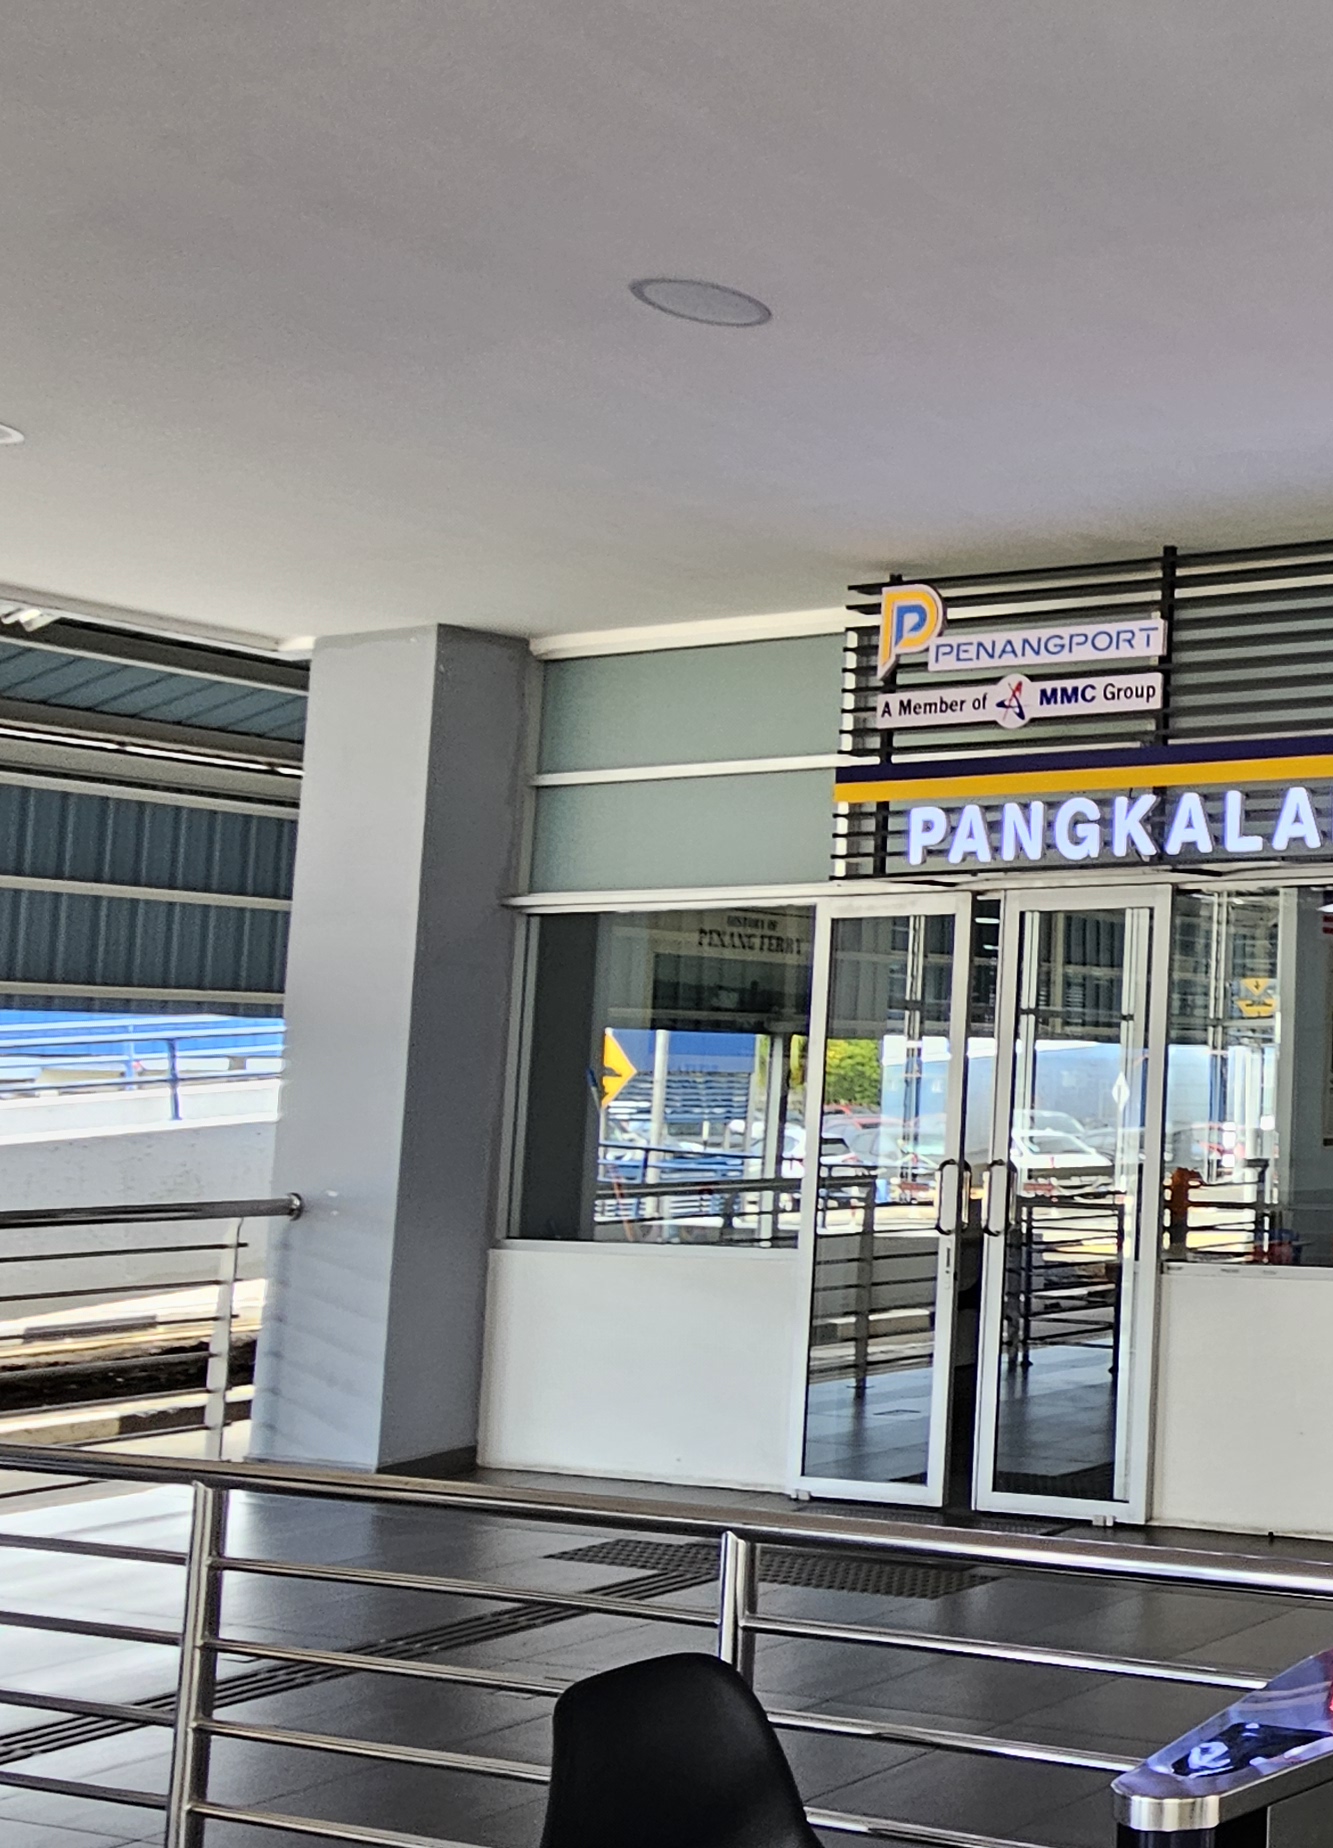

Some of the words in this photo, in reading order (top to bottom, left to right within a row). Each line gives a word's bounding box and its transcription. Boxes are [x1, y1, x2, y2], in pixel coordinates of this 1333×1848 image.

[934, 626, 1160, 664] PENANGPORT
[881, 701, 892, 718] A
[898, 692, 966, 716] Member
[972, 692, 988, 711] of
[1039, 684, 1097, 707] MMC
[1103, 682, 1156, 704] Group
